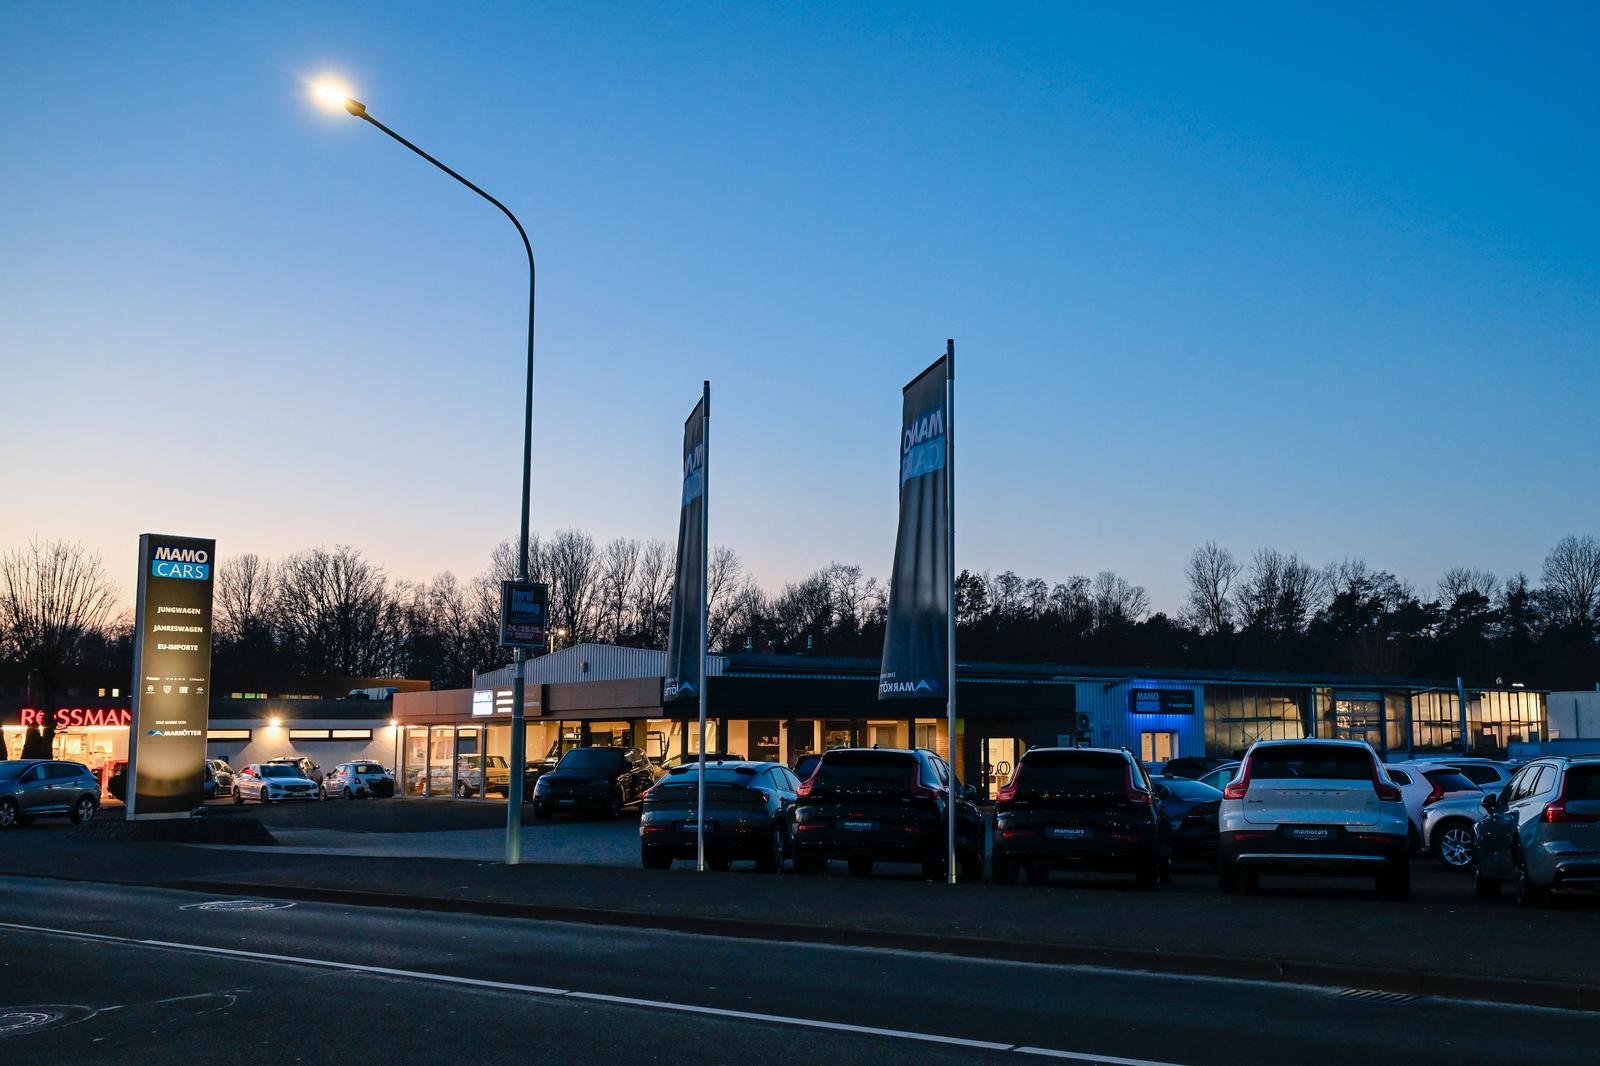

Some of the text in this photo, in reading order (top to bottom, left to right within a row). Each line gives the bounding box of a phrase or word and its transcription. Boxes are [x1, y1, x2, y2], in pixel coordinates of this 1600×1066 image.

[155, 546, 208, 564] MAMO
[157, 563, 204, 579] CARS
[157, 606, 201, 615] JUNGWAGEN
[153, 624, 203, 633] JAHRESWAGEN
[157, 643, 198, 651] EU-IMPORTE
[1136, 692, 1159, 701] MAMO
